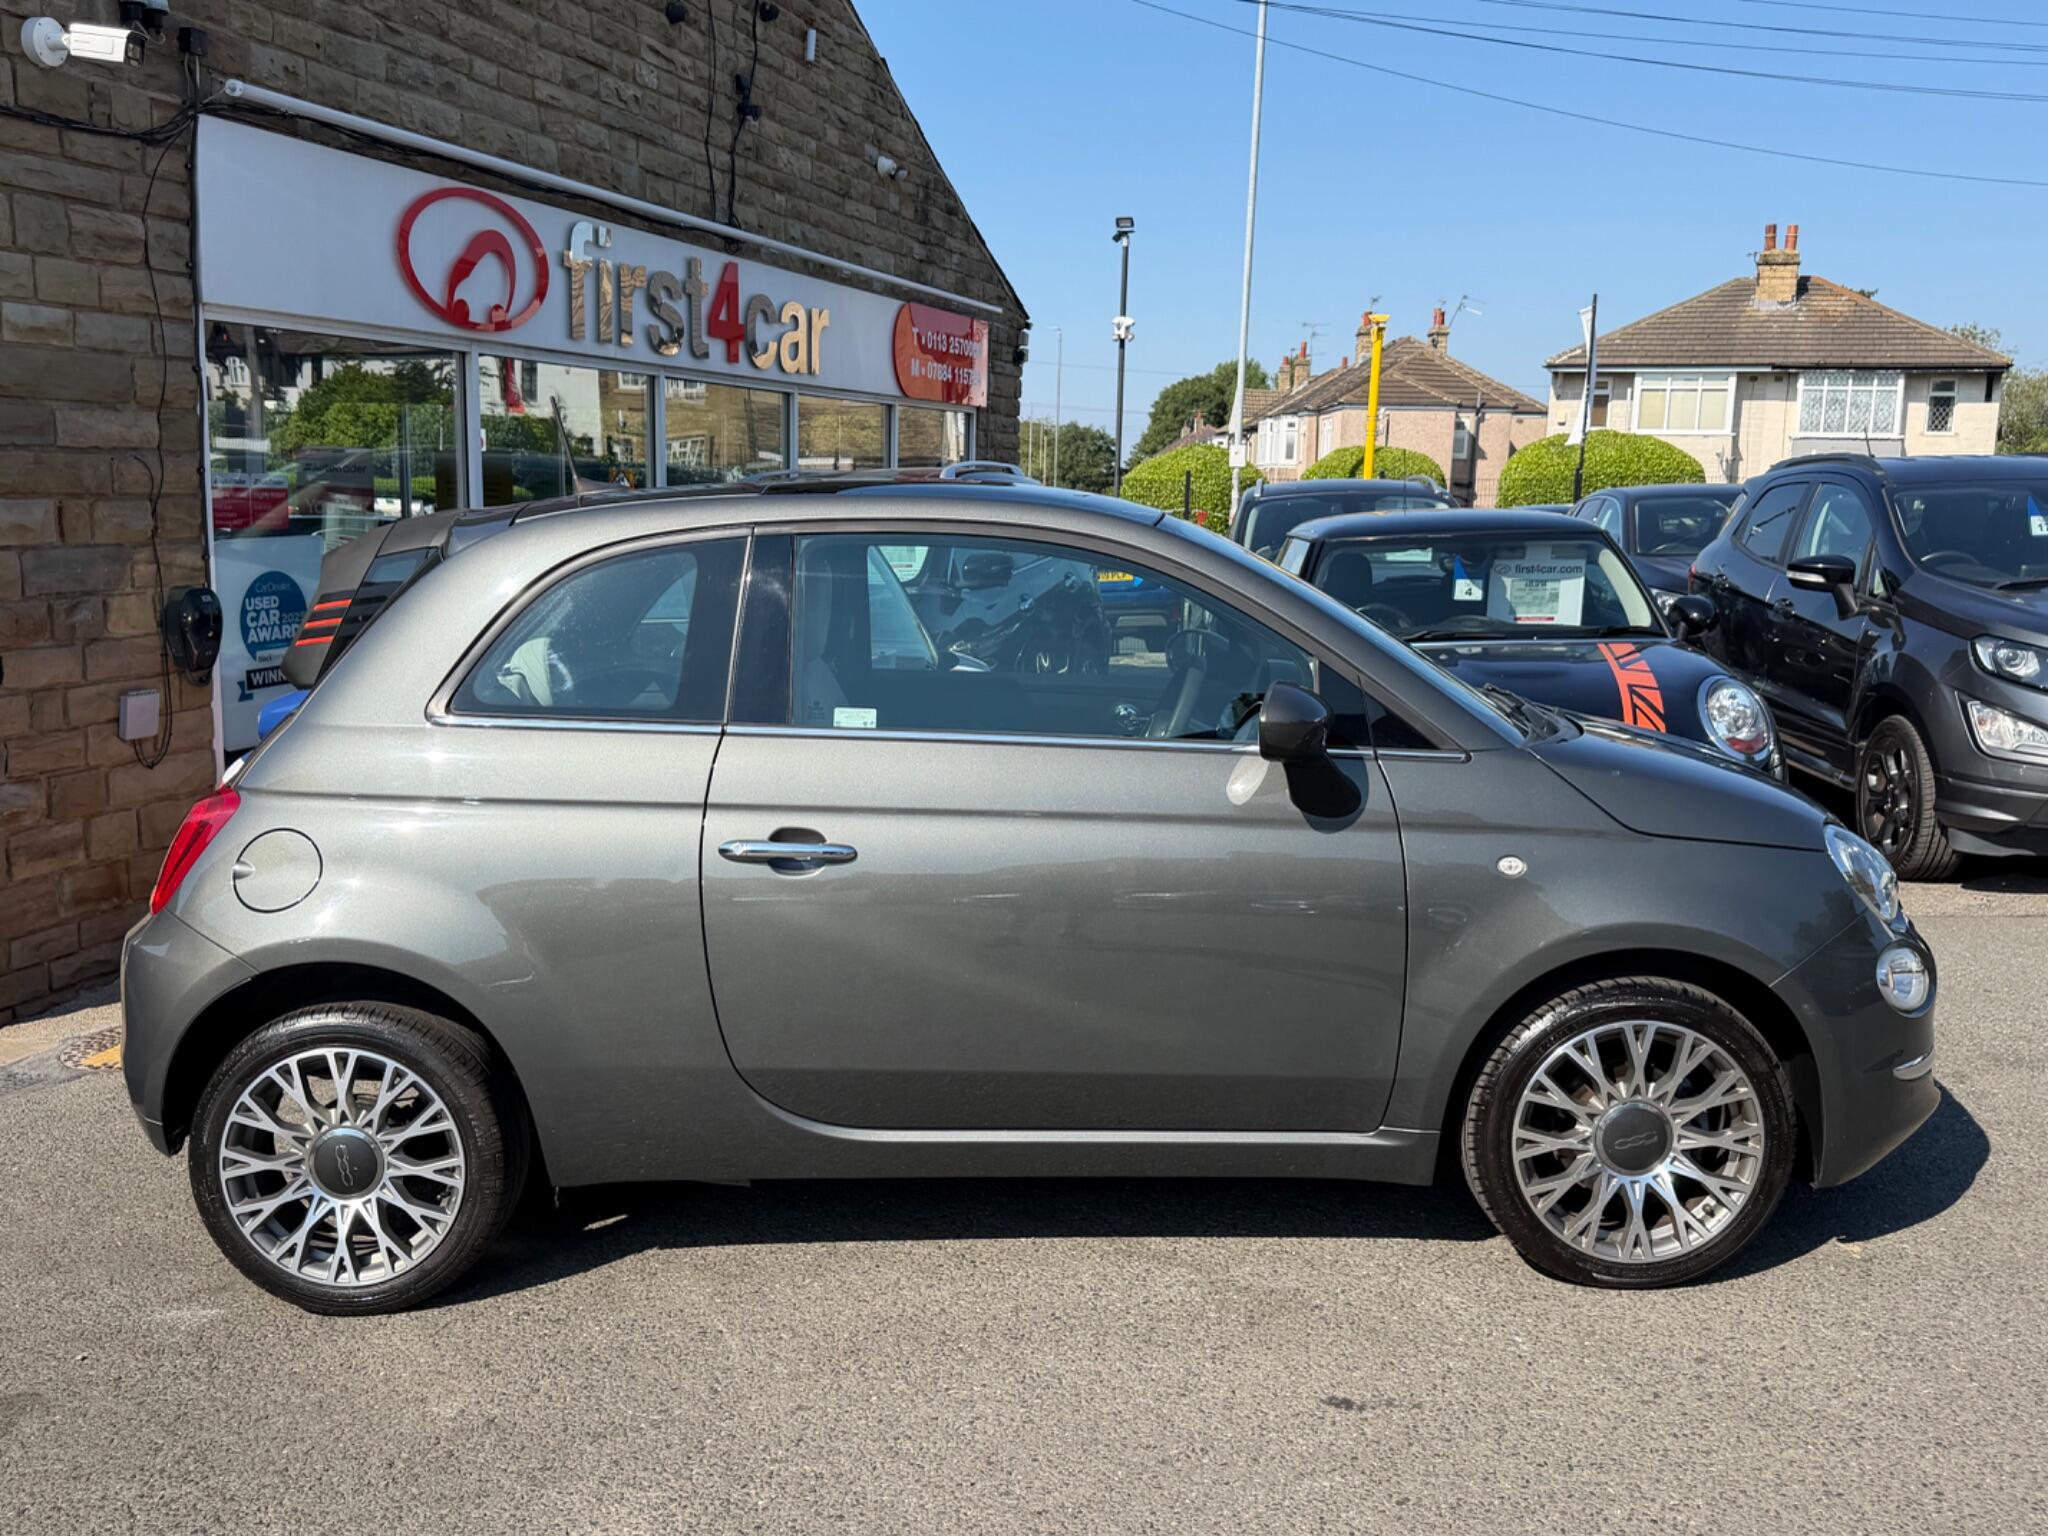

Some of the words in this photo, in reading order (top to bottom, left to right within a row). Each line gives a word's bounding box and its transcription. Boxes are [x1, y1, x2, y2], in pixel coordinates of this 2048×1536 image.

[564, 220, 830, 376] first4car
[1515, 564, 1583, 574] first4car.com
[1465, 587, 1473, 597] 4
[245, 595, 280, 610] USED
[246, 609, 280, 628] CAR
